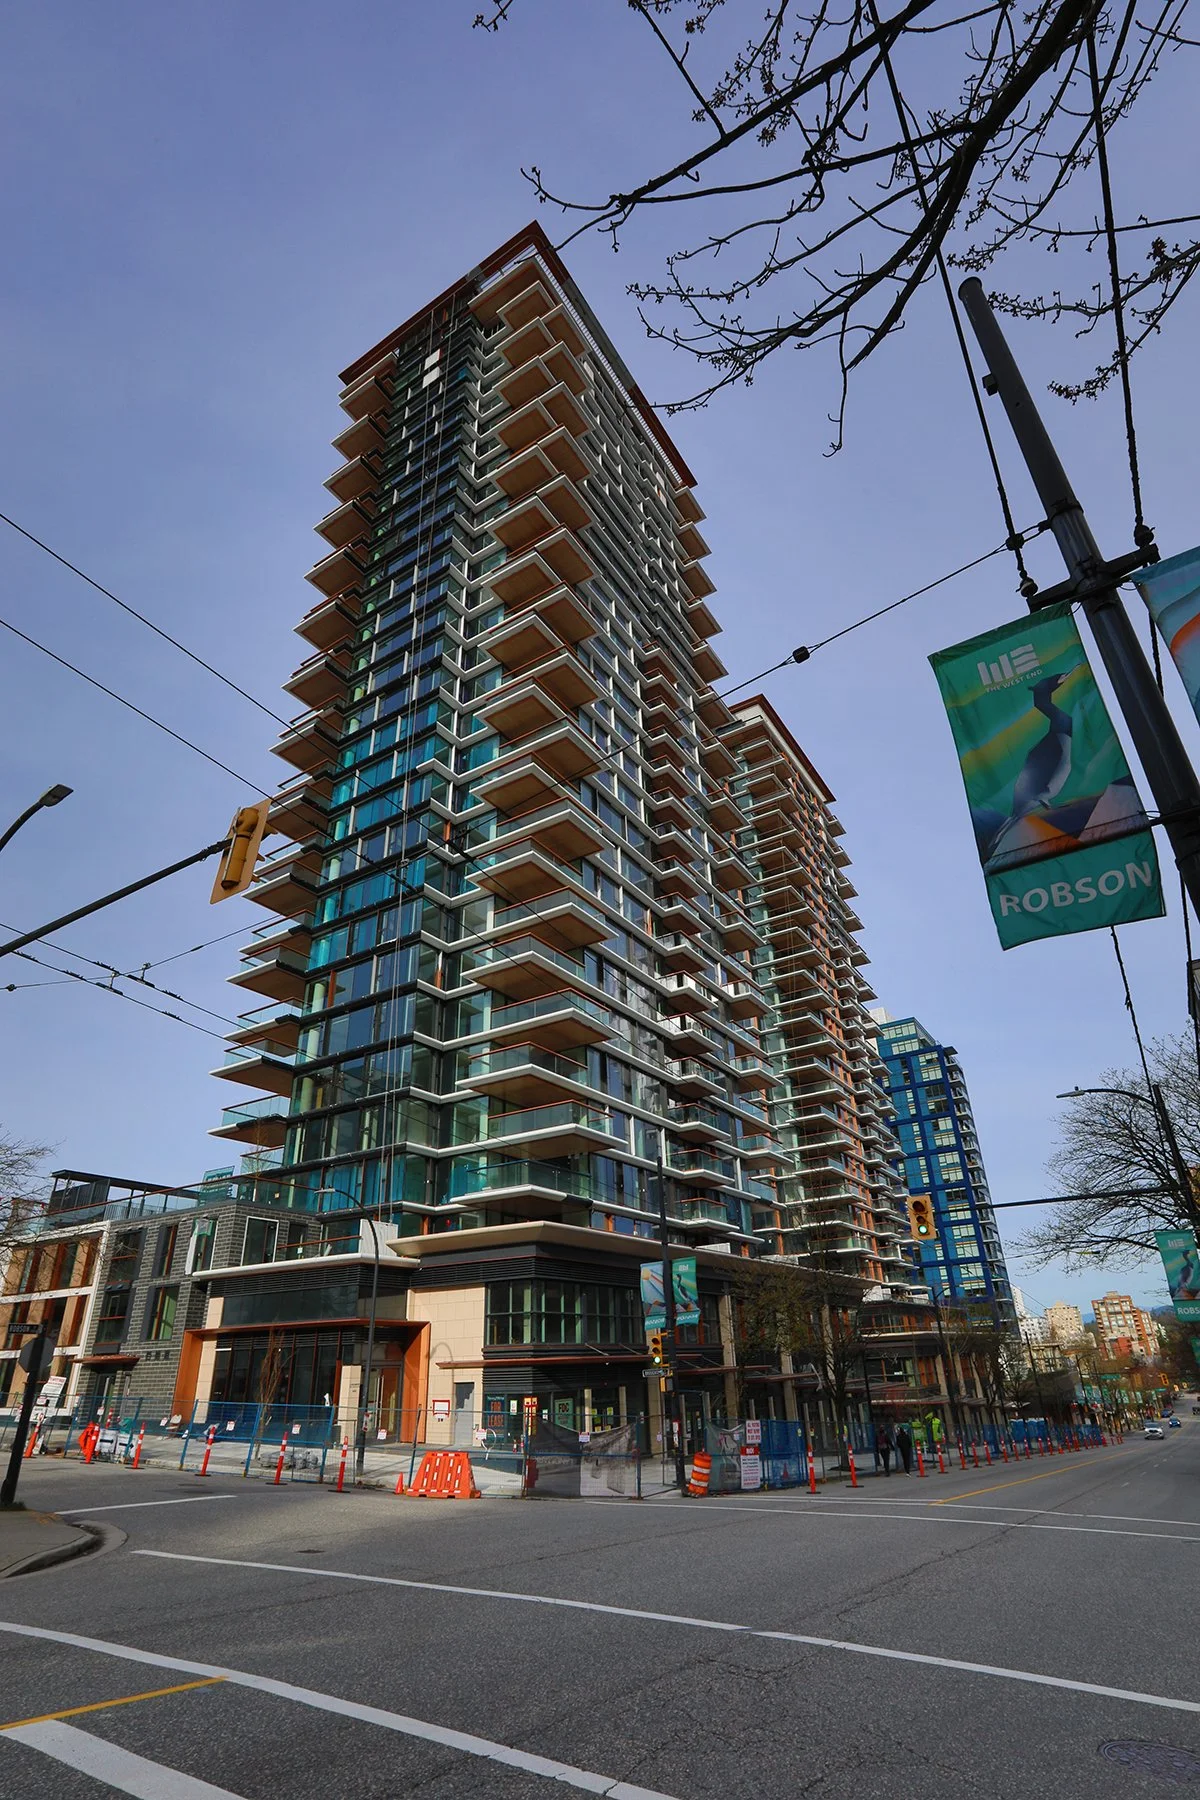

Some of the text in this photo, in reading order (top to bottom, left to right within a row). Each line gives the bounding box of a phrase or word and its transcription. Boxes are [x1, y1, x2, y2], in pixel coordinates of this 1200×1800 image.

[986, 669, 1043, 693] THE WEST END
[1000, 861, 1152, 917] ROBSON
